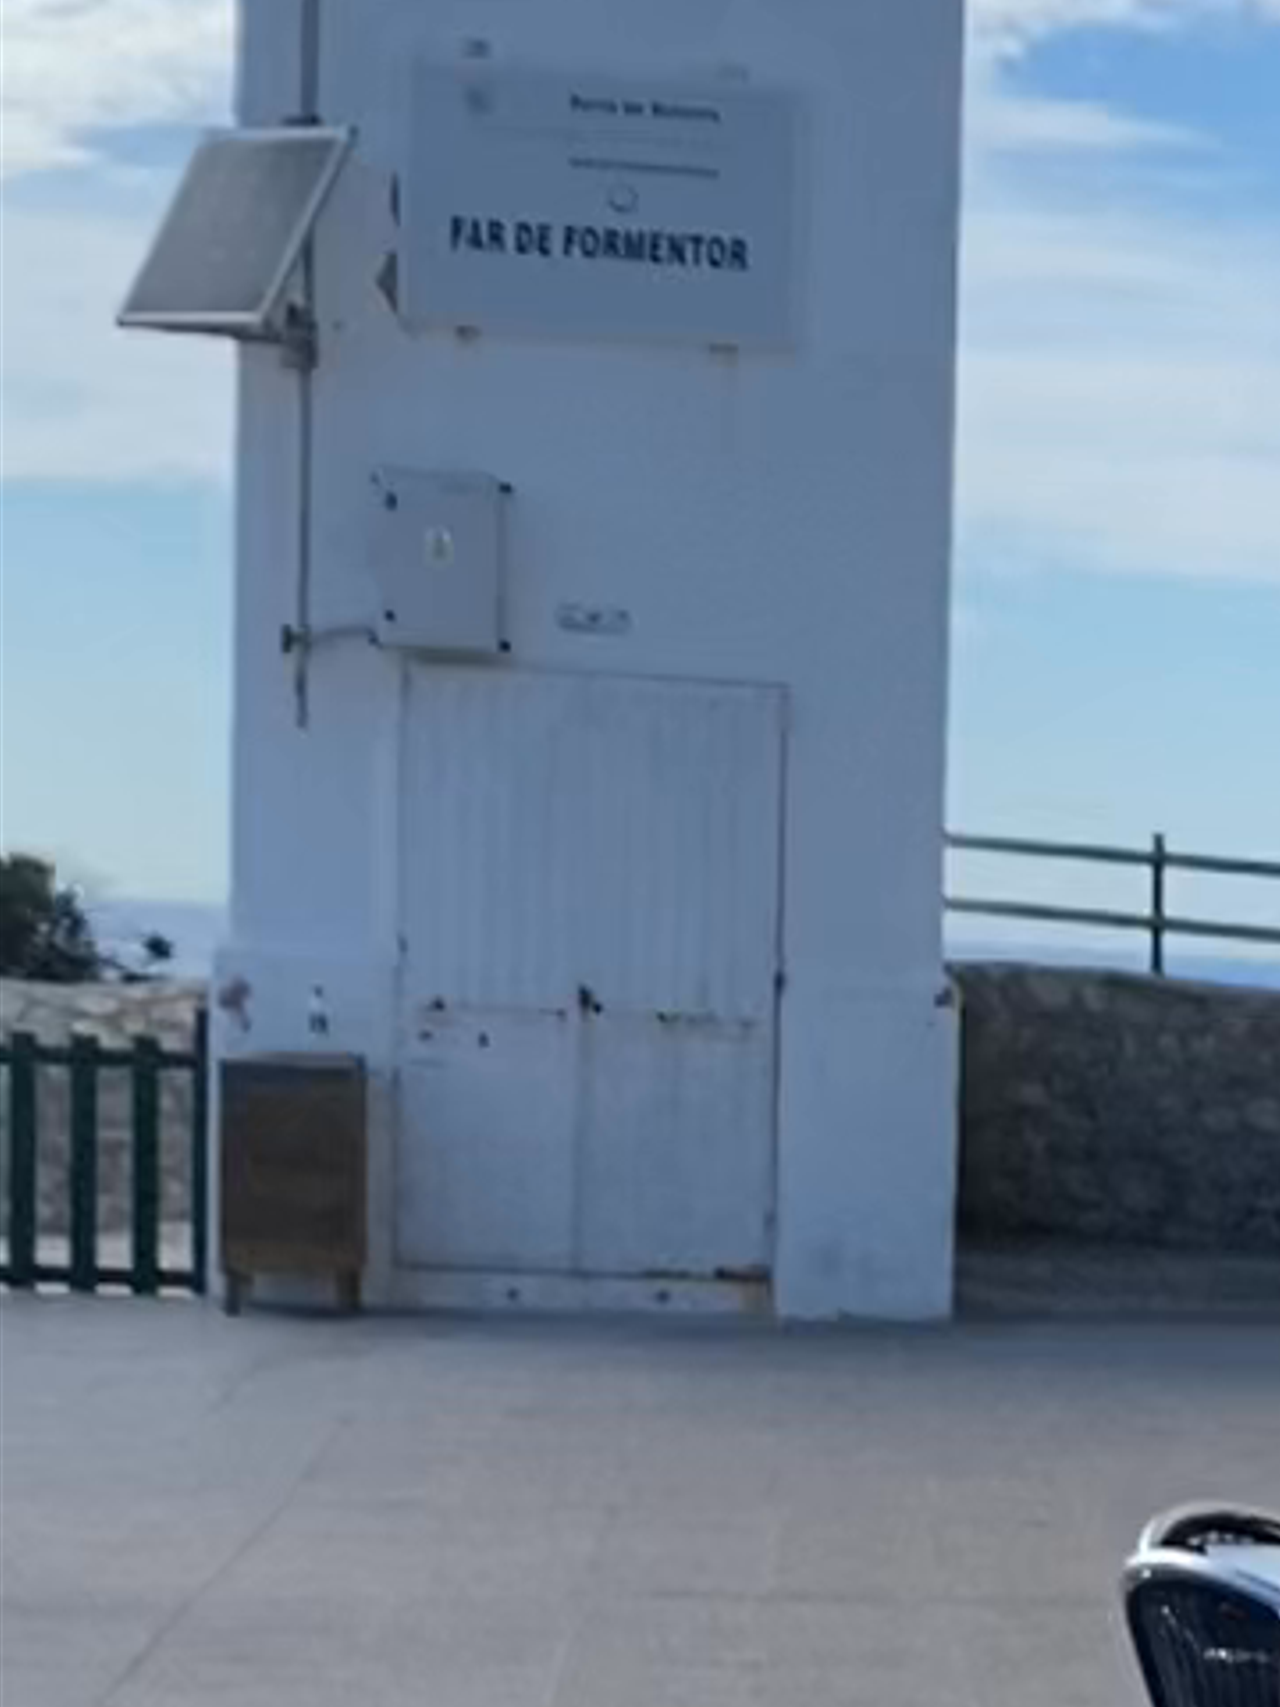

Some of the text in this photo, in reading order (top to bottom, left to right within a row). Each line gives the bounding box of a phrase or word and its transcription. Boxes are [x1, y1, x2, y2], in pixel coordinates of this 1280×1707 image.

[450, 215, 749, 270] FAR DE FORMENTOR
